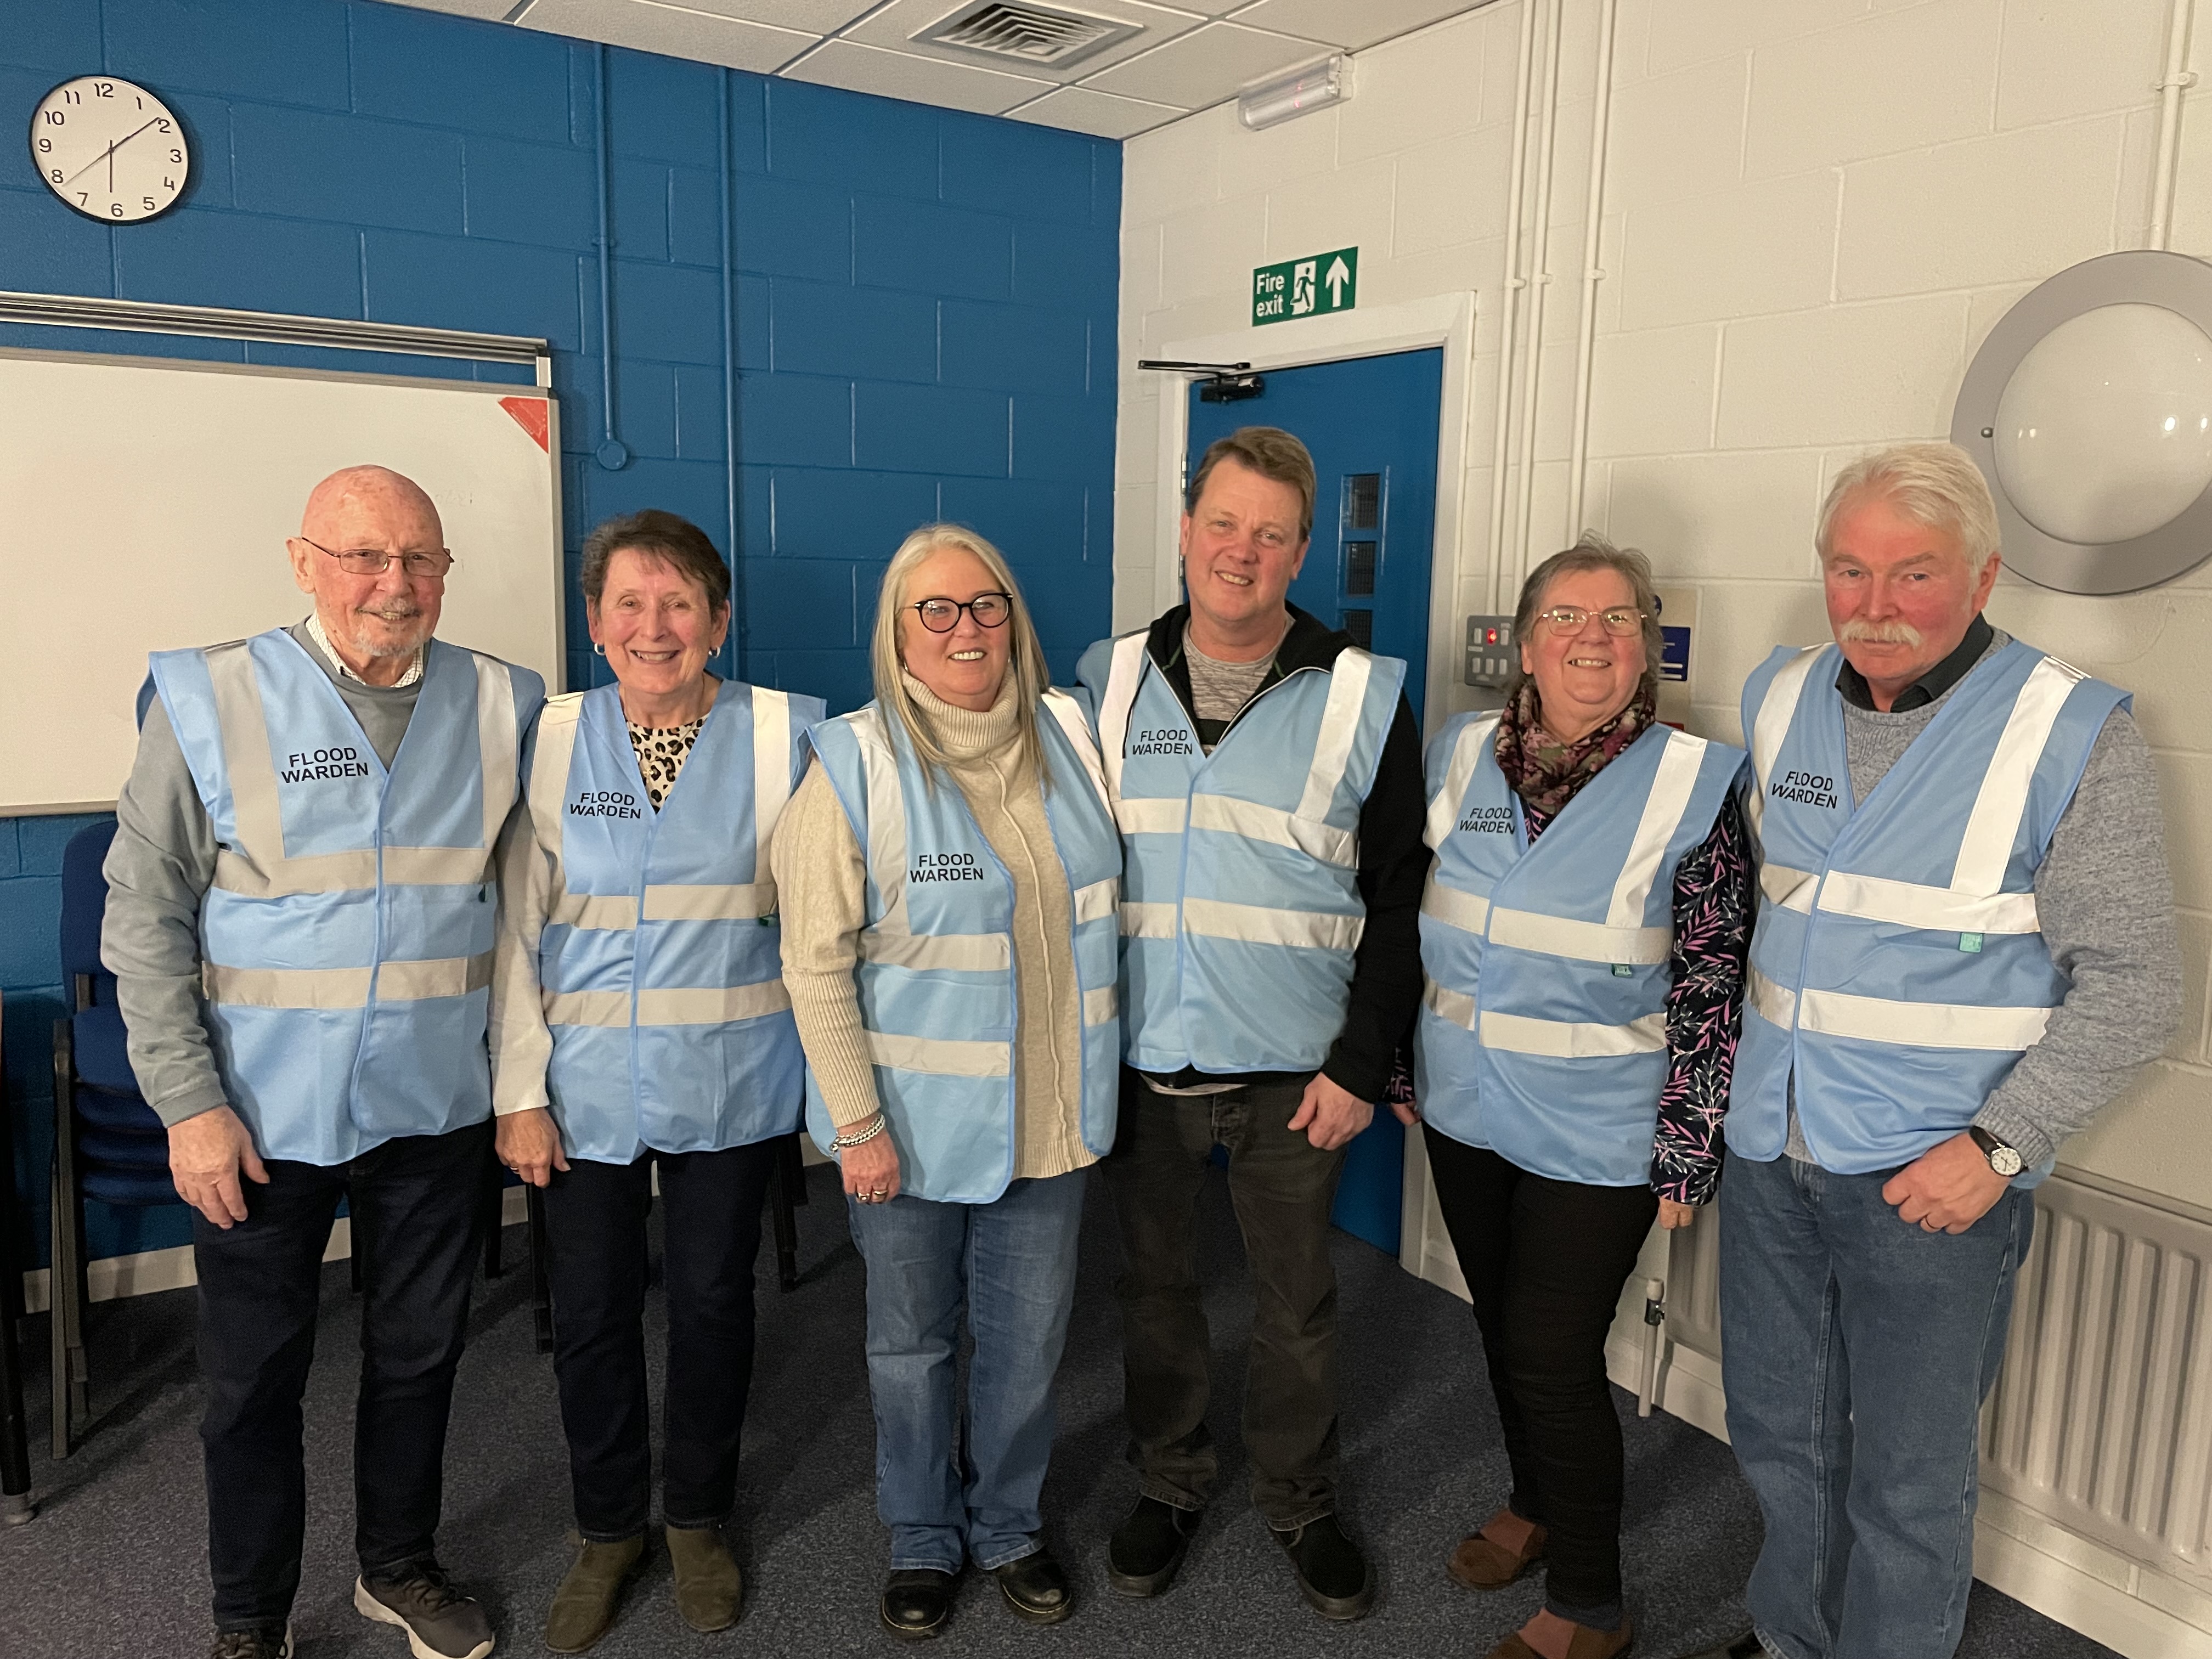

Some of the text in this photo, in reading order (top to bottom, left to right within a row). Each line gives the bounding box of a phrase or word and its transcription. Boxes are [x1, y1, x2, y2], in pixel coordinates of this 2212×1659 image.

[65, 90, 81, 105] 11
[94, 83, 114, 98] 12
[136, 96, 142, 110] 1
[44, 111, 65, 125] 10
[157, 119, 171, 133] 2
[39, 138, 52, 153] 9
[170, 149, 182, 163] 3
[52, 170, 64, 183] 8
[164, 176, 175, 191] 4
[77, 192, 88, 206] 7
[143, 196, 155, 210] 5
[111, 203, 123, 217] 6
[1256, 273, 1285, 295] Fire
[1256, 294, 1284, 317] exit
[1141, 730, 1187, 742] FLOOD
[1132, 743, 1193, 755] WARDEN
[289, 748, 357, 768] FLOOD
[281, 763, 369, 783] WARDEN
[1785, 771, 1833, 791] FLOOD
[580, 792, 635, 805] FLOOD
[1771, 783, 1837, 809] WARDEN
[570, 804, 641, 819] WARDEN
[1470, 808, 1513, 819] FLOOD
[1459, 820, 1515, 834] WARDEN
[919, 854, 974, 867] FLOOD
[910, 868, 984, 883] WARDEN
